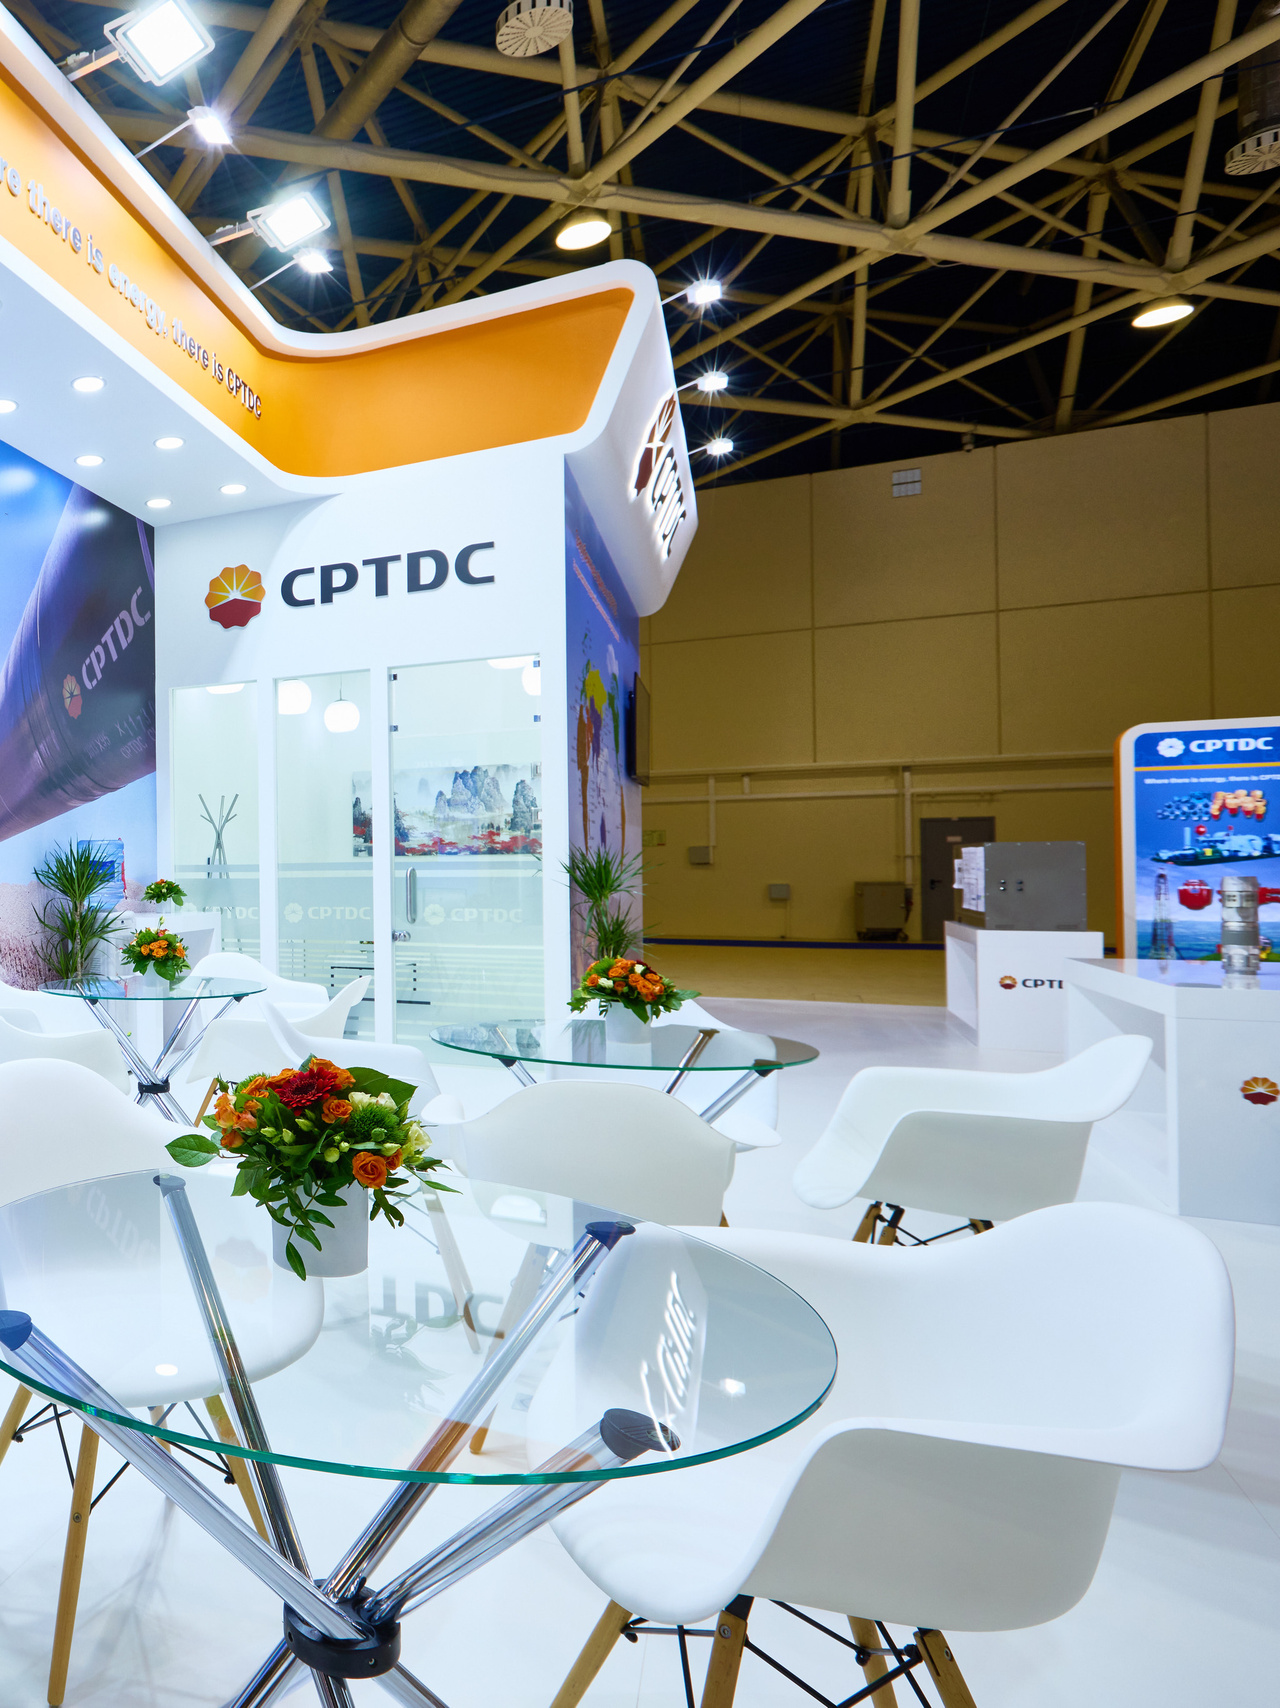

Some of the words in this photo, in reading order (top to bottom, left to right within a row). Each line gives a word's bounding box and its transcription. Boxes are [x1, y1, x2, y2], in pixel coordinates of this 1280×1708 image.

[27, 179, 82, 254] there
[86, 233, 104, 274] is
[108, 263, 169, 338] energy,
[171, 317, 209, 370] there
[211, 352, 224, 384] is
[224, 367, 262, 420] CPTDC
[280, 541, 495, 608] CPTDC
[81, 585, 152, 691] CPTDC
[1188, 737, 1274, 753] CPTDC
[307, 906, 371, 920] CPTDC
[450, 908, 523, 923] CPTDC
